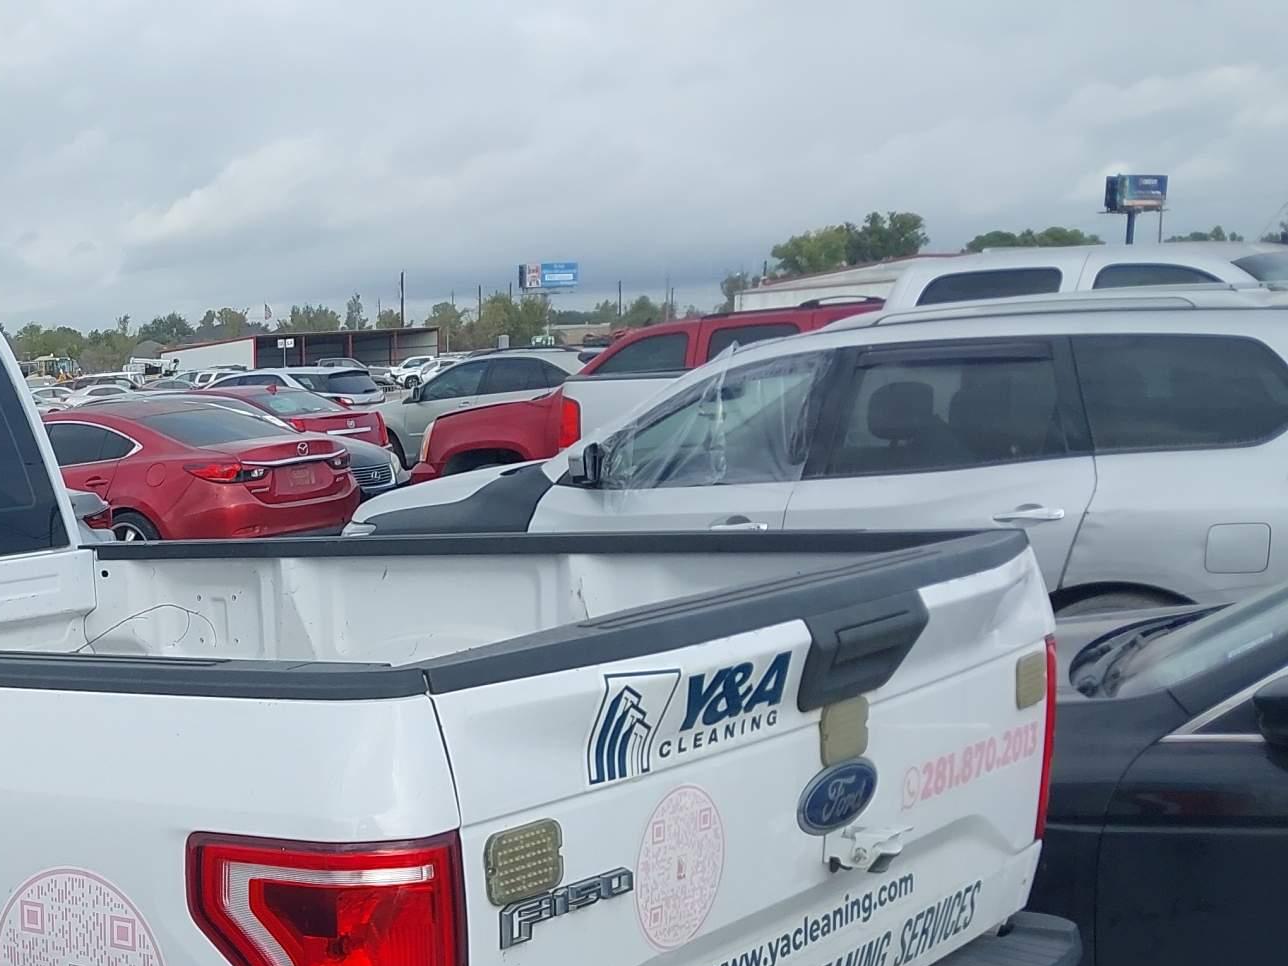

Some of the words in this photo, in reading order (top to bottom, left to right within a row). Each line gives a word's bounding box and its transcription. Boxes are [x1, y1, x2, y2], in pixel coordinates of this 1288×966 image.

[679, 650, 792, 731] Y&A
[659, 710, 778, 758] CLEANING
[921, 721, 1039, 800] 281.870.2013
[822, 775, 867, 822] Ford
